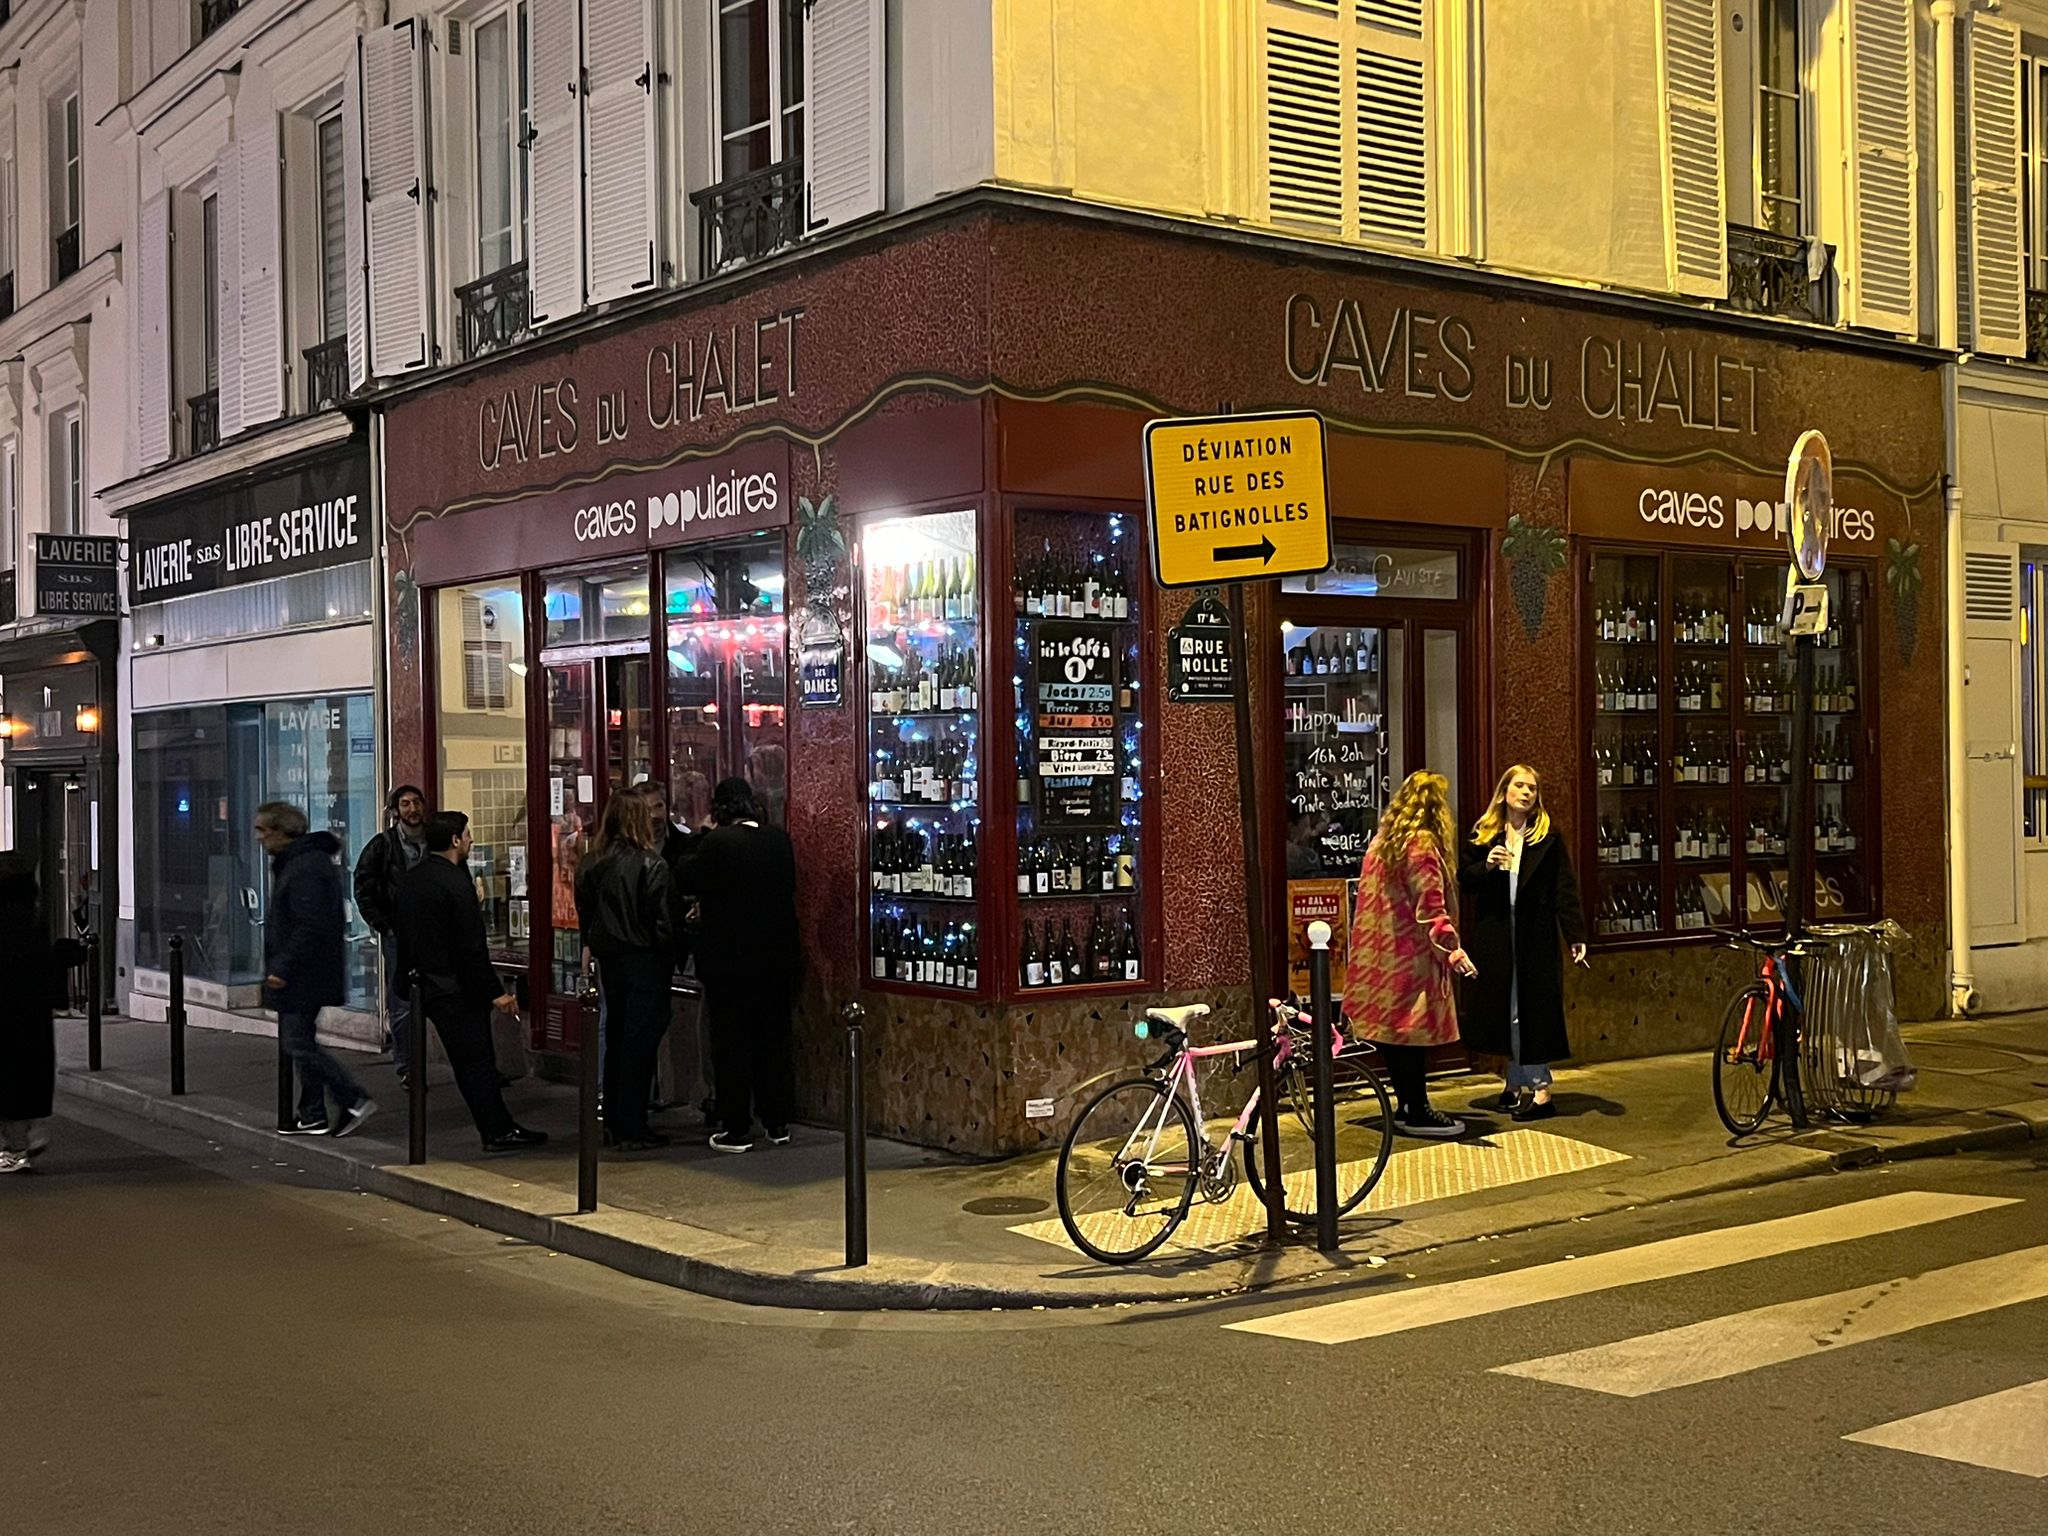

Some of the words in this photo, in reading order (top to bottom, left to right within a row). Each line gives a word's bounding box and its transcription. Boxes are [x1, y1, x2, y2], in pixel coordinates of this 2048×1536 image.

[1285, 293, 1476, 402] CAVES
[1506, 354, 1552, 411] DU
[1581, 335, 1767, 435] CHALET
[479, 377, 579, 472] CAVES
[597, 389, 629, 445] DU
[646, 312, 805, 430] CHALET
[1183, 436, 1291, 462] DÉVIATION
[1195, 475, 1234, 496] RUE
[1247, 471, 1284, 491] DES
[574, 499, 636, 541] caves
[647, 469, 777, 538] populaires
[1175, 502, 1308, 532] BATIGNOLLES
[1639, 488, 1724, 528] caves
[1736, 499, 1875, 541] popires
[39, 540, 112, 562] LAVERIE
[136, 538, 192, 591] LAVERIE
[225, 495, 358, 571] LIBRE-SERVICE
[40, 590, 69, 610] LIBRE
[72, 591, 115, 611] SERVICE
[1789, 592, 1804, 629] P
[1195, 640, 1224, 654] RUE
[1182, 658, 1232, 673] NOLLE
[804, 679, 838, 694] DAMES
[279, 708, 341, 731] LAVAGE
[1293, 702, 1341, 745] Happy
[1308, 747, 1337, 765] 16h
[1340, 742, 1364, 762] 20h
[1296, 770, 1329, 789] Pinte
[1297, 794, 1326, 813] Pinte
